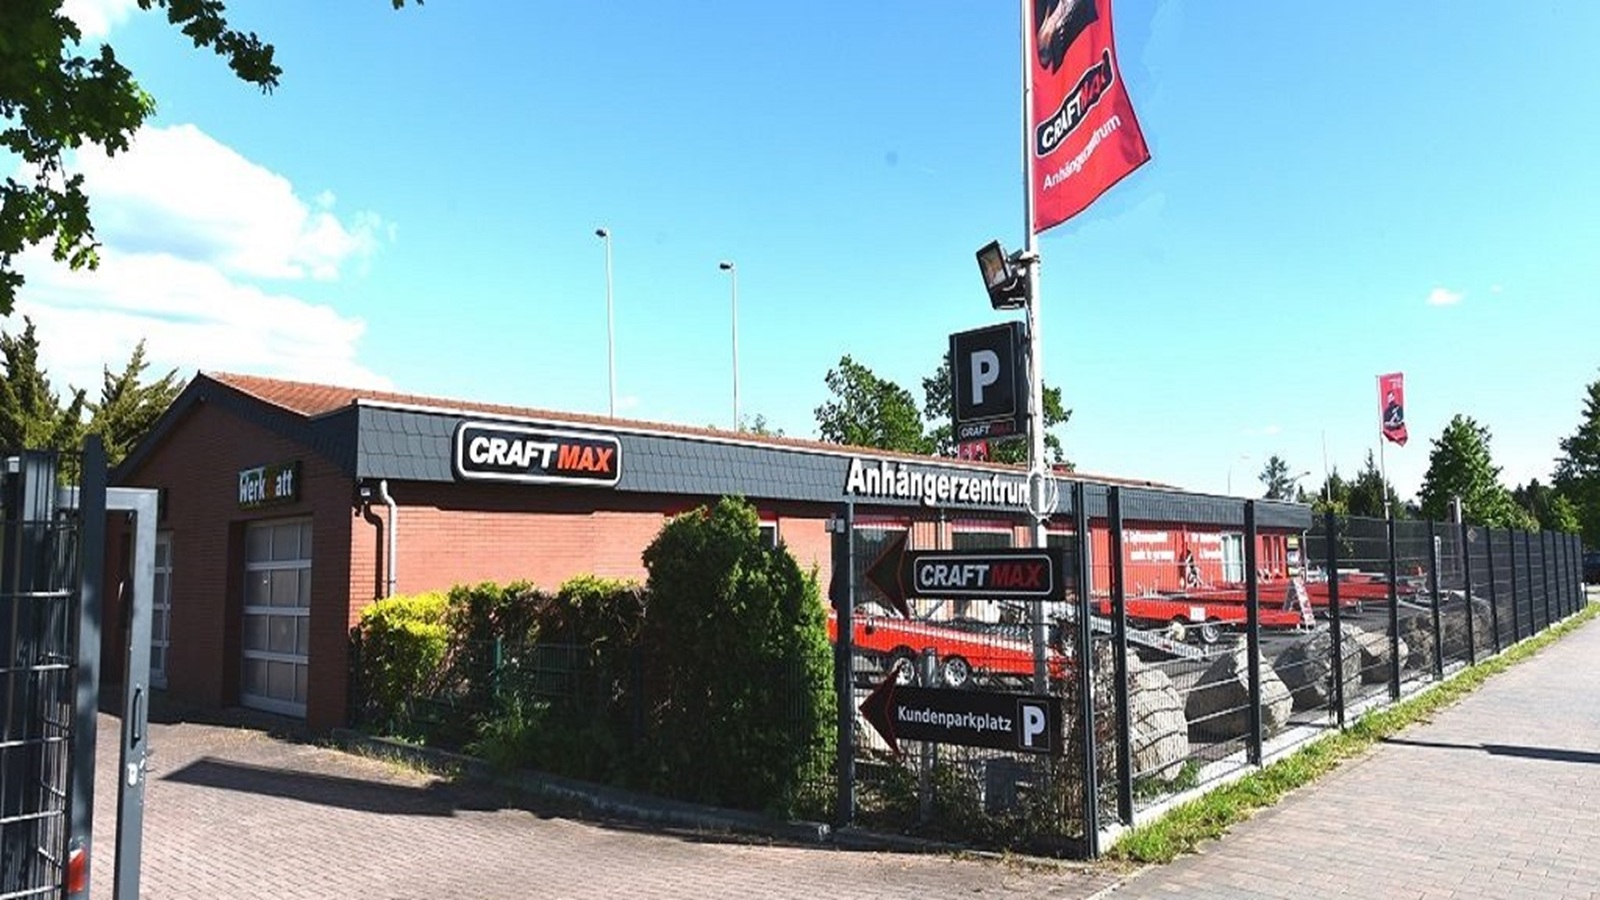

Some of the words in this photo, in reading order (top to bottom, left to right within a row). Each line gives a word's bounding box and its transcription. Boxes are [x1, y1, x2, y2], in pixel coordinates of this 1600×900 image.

[971, 350, 1000, 405] P
[898, 706, 1012, 732] Kundenparkplatz
[1023, 706, 1045, 746] P
